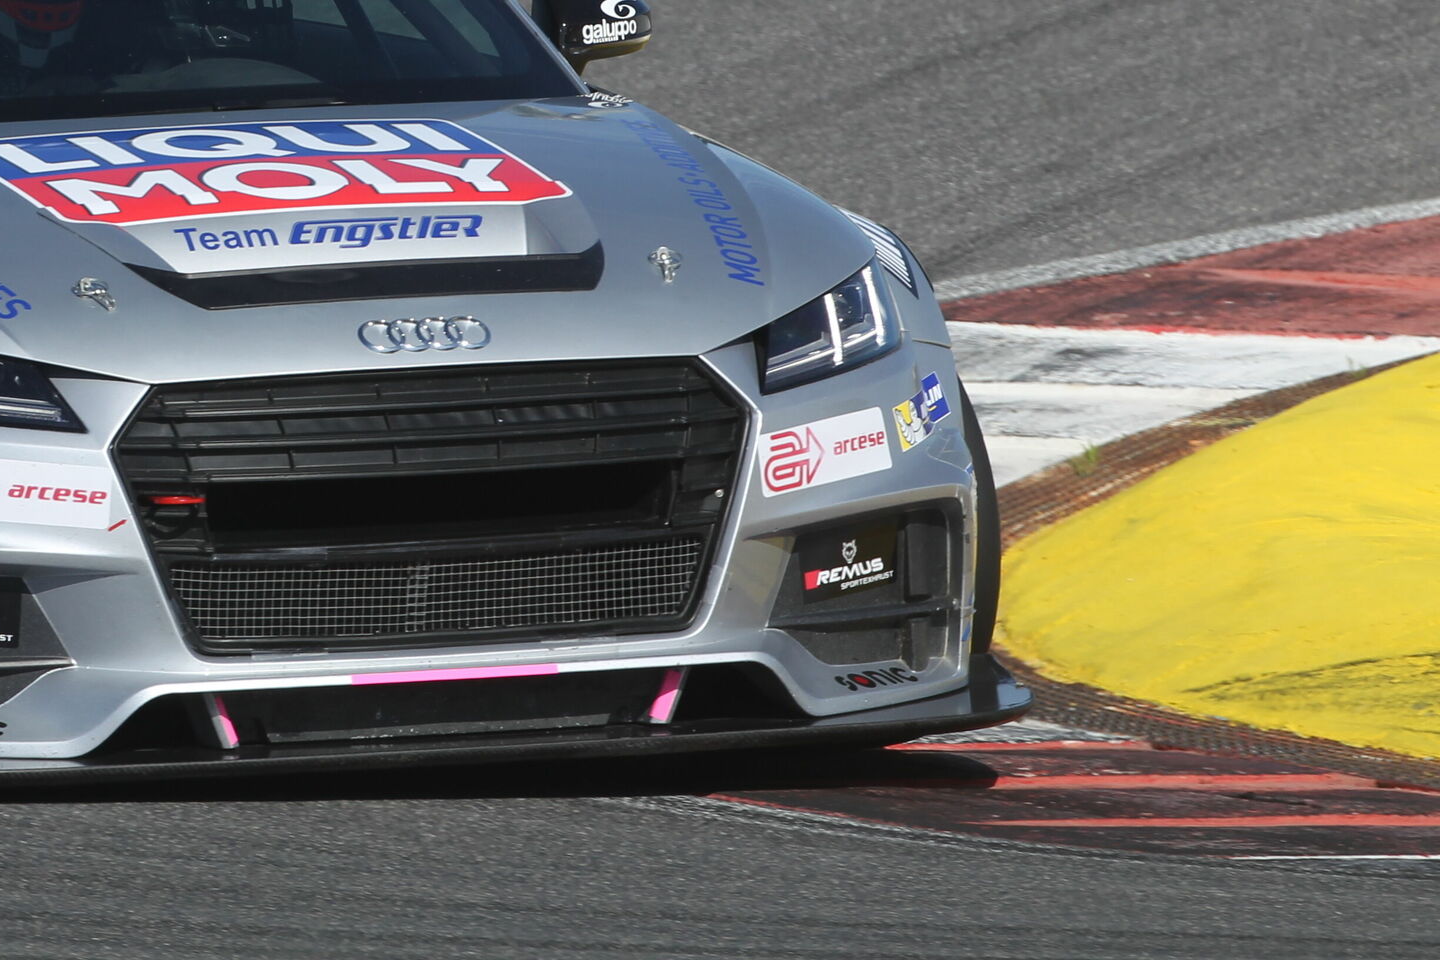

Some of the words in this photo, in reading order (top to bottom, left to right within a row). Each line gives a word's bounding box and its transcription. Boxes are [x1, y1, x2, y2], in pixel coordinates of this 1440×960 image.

[582, 18, 637, 45] galuppo
[45, 156, 510, 217] MOLY
[678, 176, 733, 211] OILS
[174, 224, 280, 253] Team
[703, 213, 765, 287] MOTOR
[833, 430, 885, 456] arcese
[7, 482, 108, 505] arcese
[816, 557, 884, 586] REMUS
